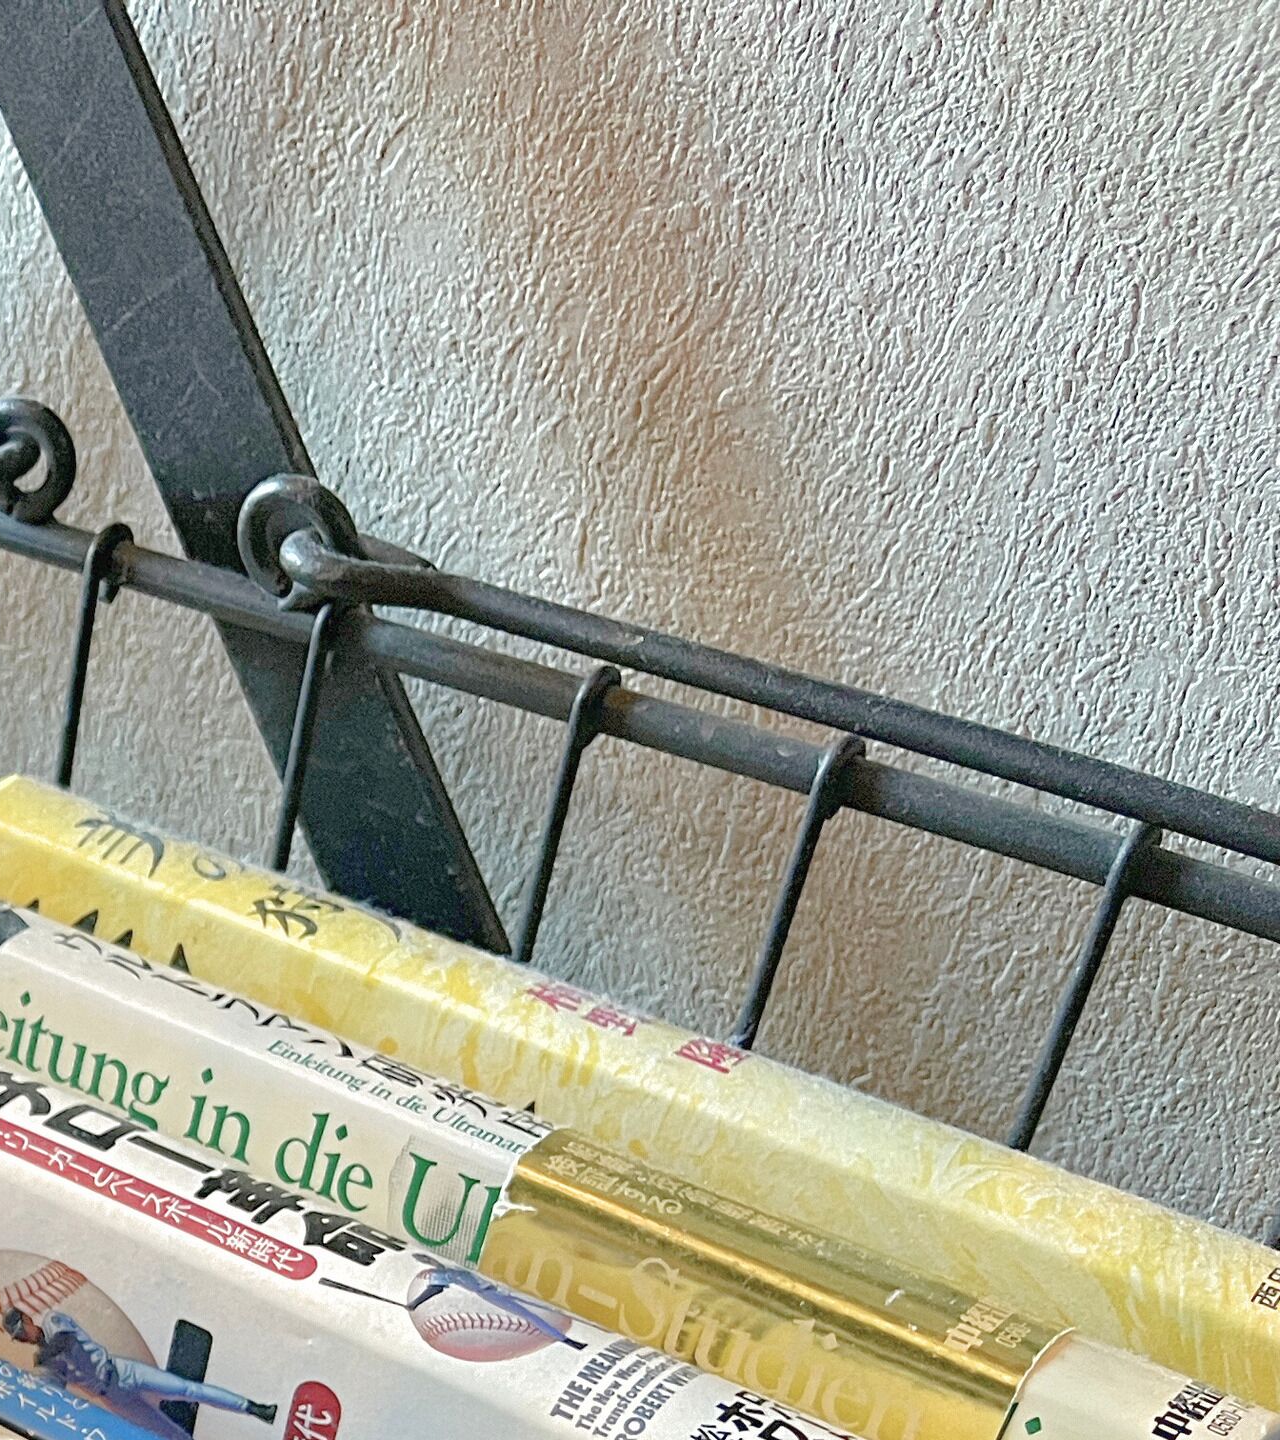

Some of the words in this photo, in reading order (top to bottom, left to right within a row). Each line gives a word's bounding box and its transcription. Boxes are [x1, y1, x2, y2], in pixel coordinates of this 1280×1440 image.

[267, 1039, 368, 1092] Einleitung
[369, 1080, 396, 1100] in
[397, 1092, 429, 1114] die
[184, 1067, 251, 1164] in
[275, 1112, 374, 1211] die
[550, 1380, 591, 1420] THE
